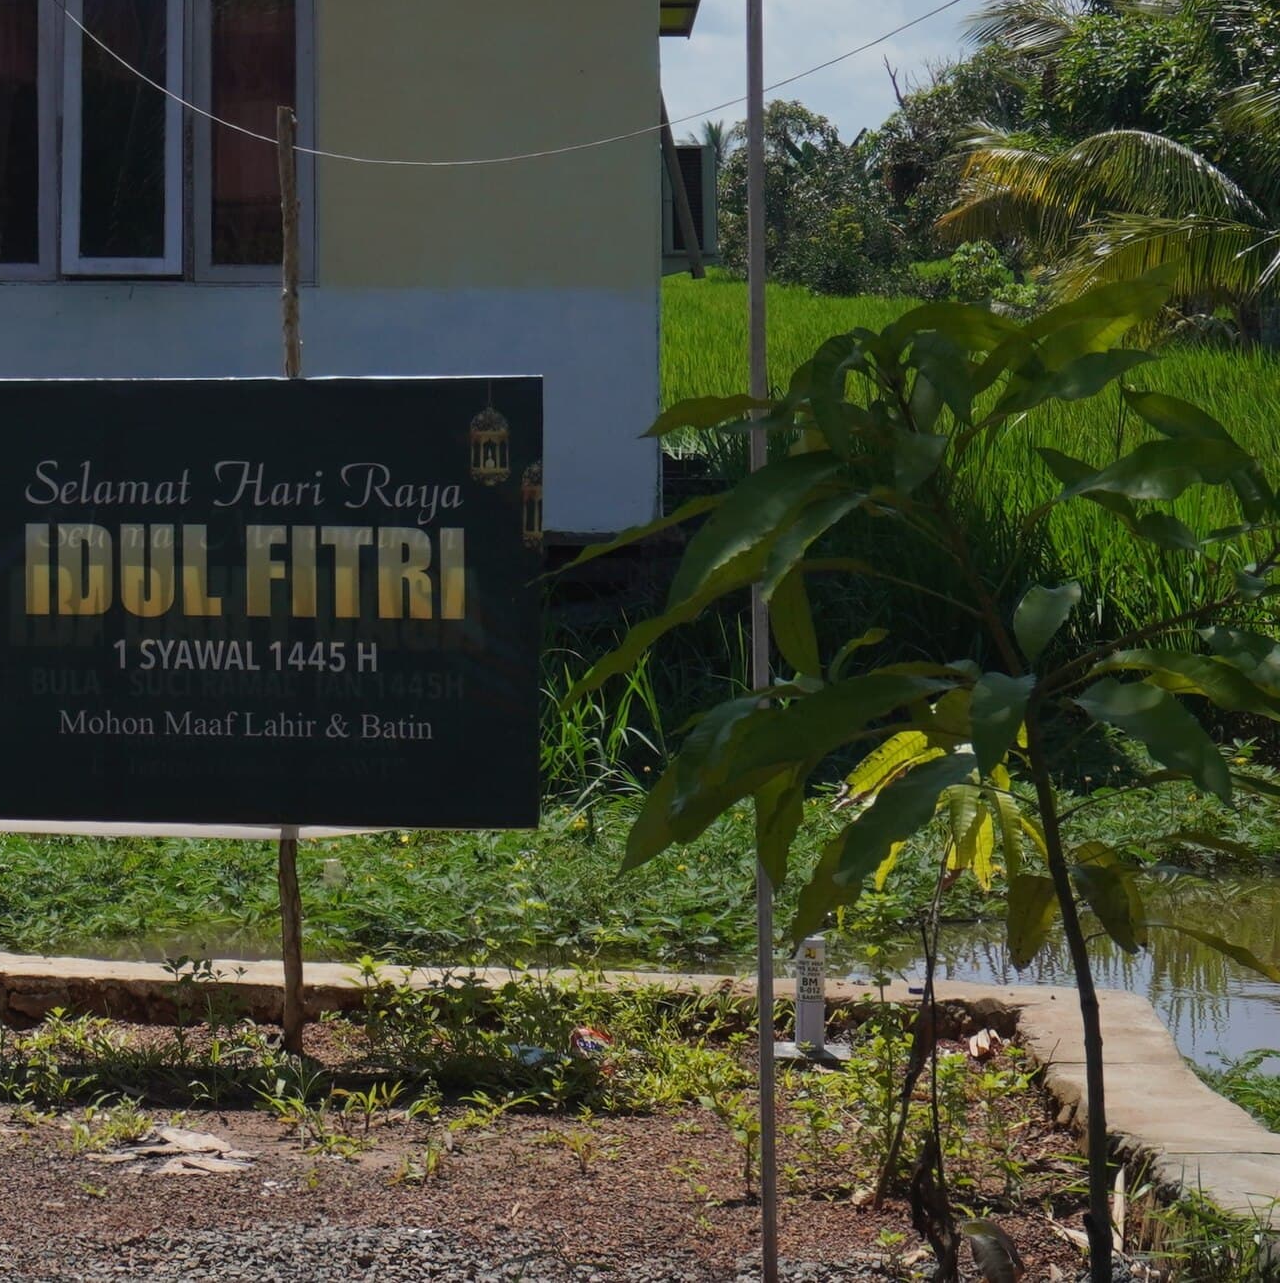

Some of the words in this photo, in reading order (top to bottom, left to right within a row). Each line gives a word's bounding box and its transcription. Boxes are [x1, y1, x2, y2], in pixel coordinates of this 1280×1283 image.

[24, 460, 192, 506] Selamat
[213, 460, 324, 507] Hari
[340, 461, 464, 525] Raya
[25, 523, 222, 618] IDUL
[245, 524, 465, 620] FITRI
[113, 639, 126, 669] 1
[139, 638, 260, 671] SYAWAL
[269, 640, 346, 673] 1445
[357, 641, 377, 673] H
[60, 709, 155, 735] Mohon
[165, 710, 239, 736] Maaf
[244, 712, 317, 737] Lahir
[325, 713, 349, 738] &
[361, 714, 432, 740] Batin
[802, 977, 818, 986] BM
